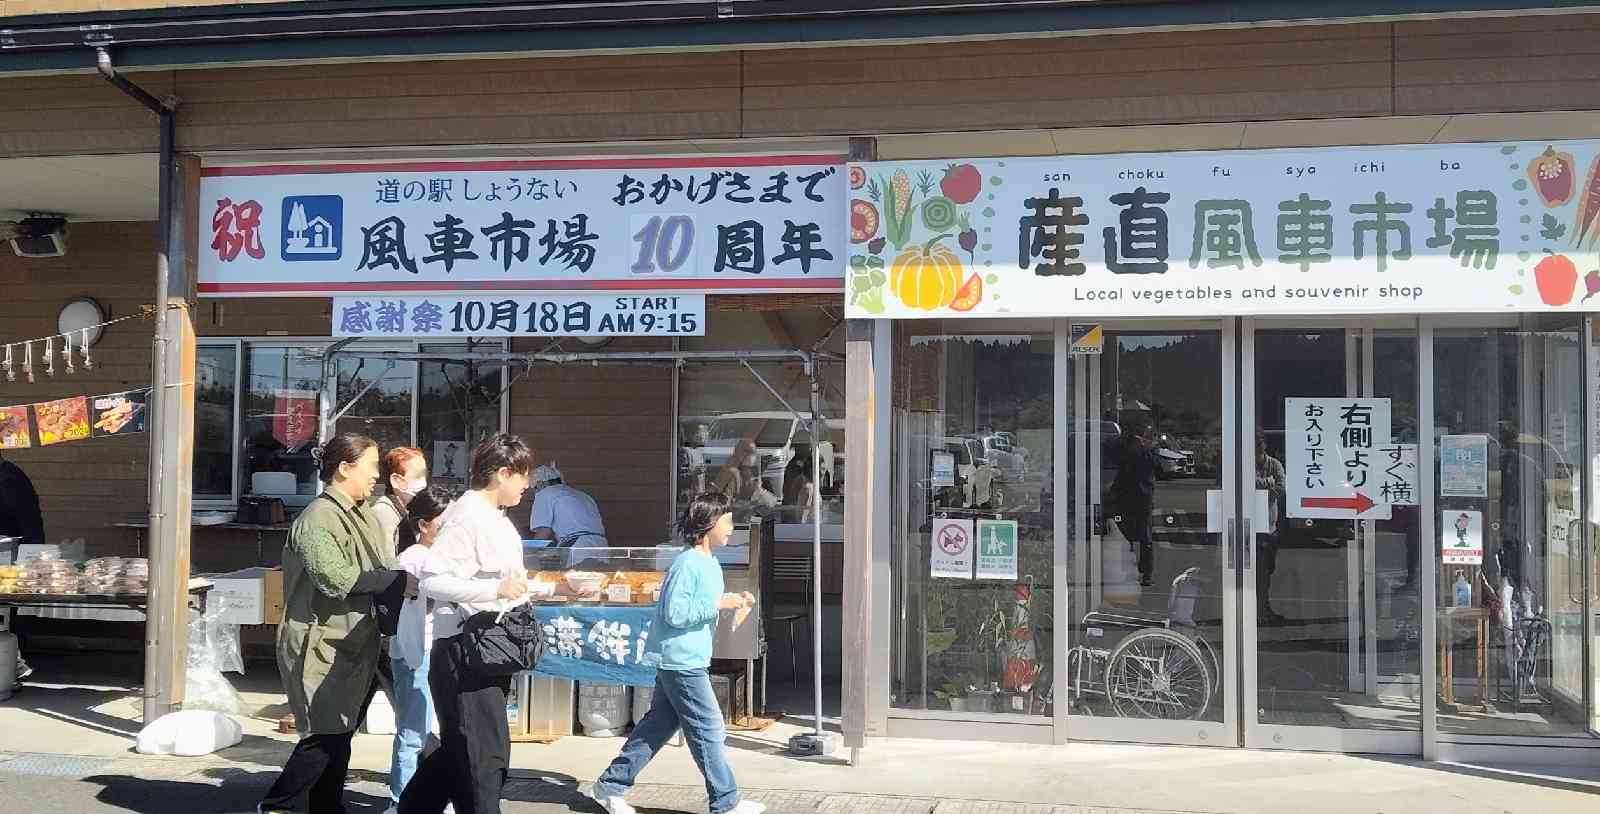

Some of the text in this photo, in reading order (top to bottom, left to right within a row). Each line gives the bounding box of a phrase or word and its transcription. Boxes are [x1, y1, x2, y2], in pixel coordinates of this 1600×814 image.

[612, 165, 838, 207] おかげさまで
[1043, 159, 1462, 182] san choku fu sya ichi ba
[211, 196, 266, 262] 祝
[355, 211, 600, 275] 風車市場
[615, 297, 681, 311] START
[1073, 283, 1424, 304] Local vegetables and souvenir shop
[1304, 403, 1325, 489] お入り下さい
[1340, 403, 1373, 488] 右側より
[1379, 445, 1416, 503] すぐ横
